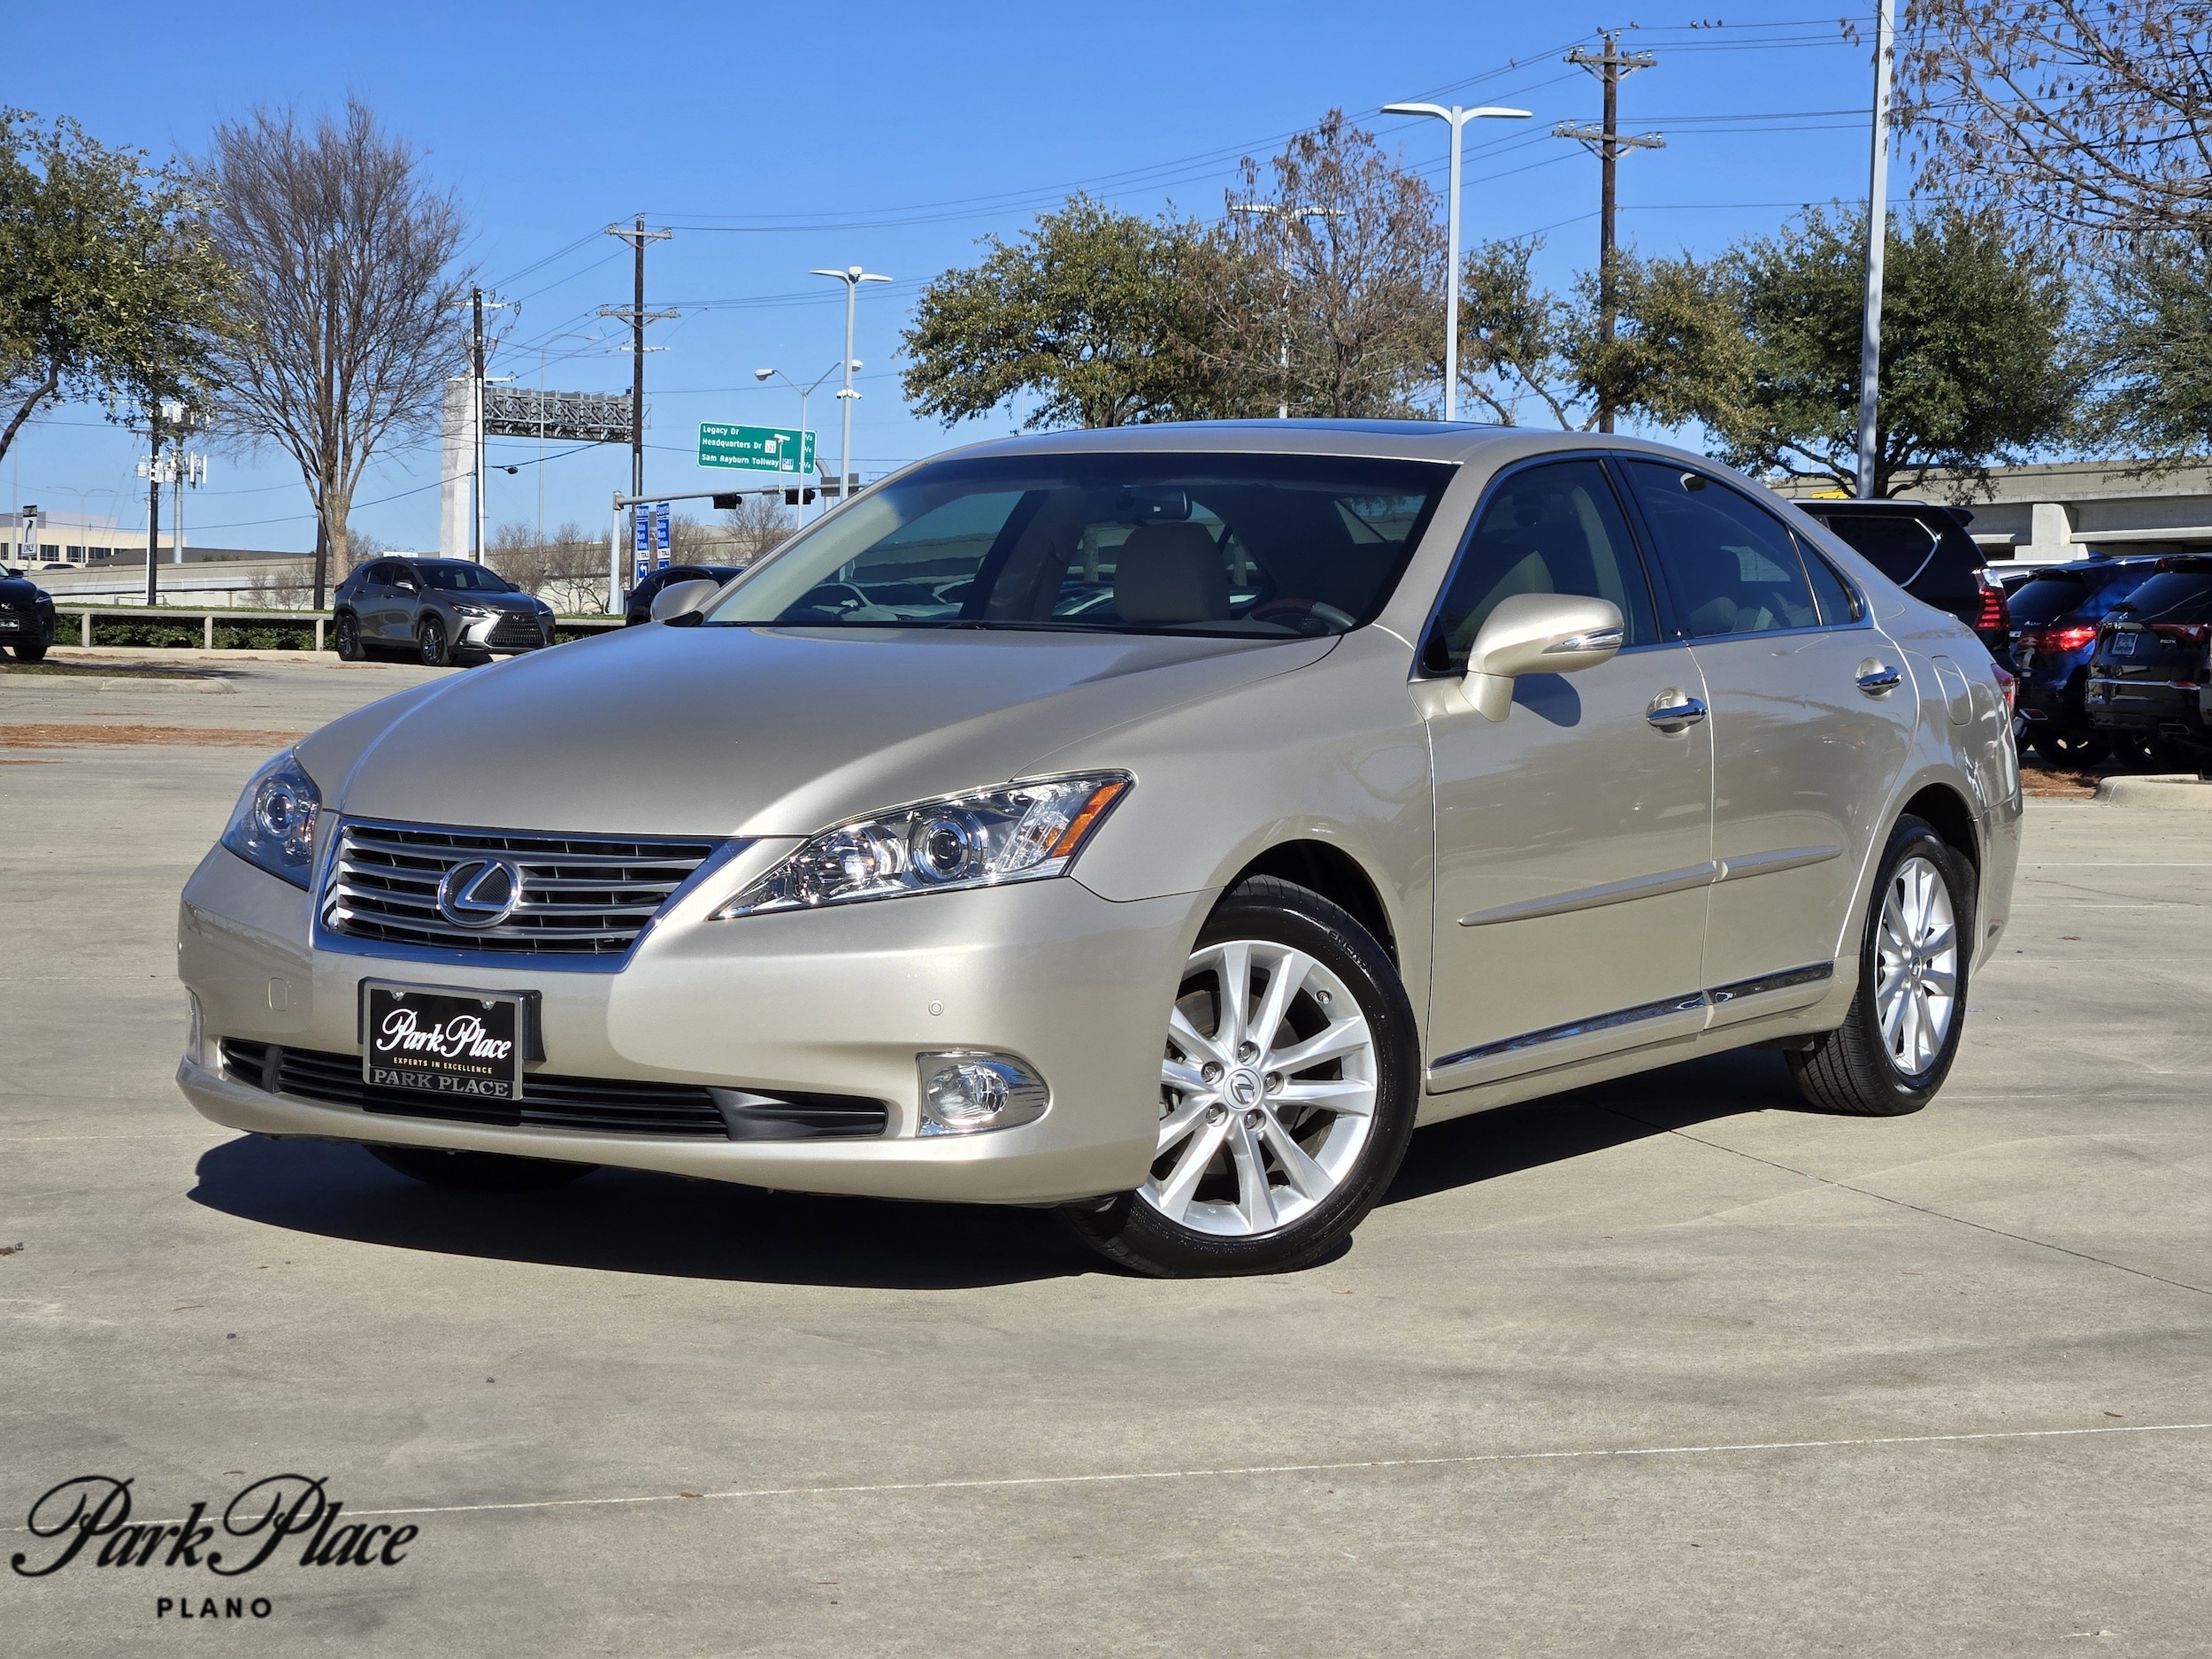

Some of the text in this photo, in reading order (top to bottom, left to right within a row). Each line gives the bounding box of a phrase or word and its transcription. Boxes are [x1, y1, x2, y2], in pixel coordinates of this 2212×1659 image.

[703, 426, 728, 435] Legacy
[703, 438, 751, 449] Headquarters
[702, 453, 780, 468] Sam Rayburn Tollway
[376, 1008, 512, 1060] Park Place
[393, 1056, 493, 1074] EXPERTS IN EXCELLENCE
[373, 1068, 510, 1097] PARK PLACE
